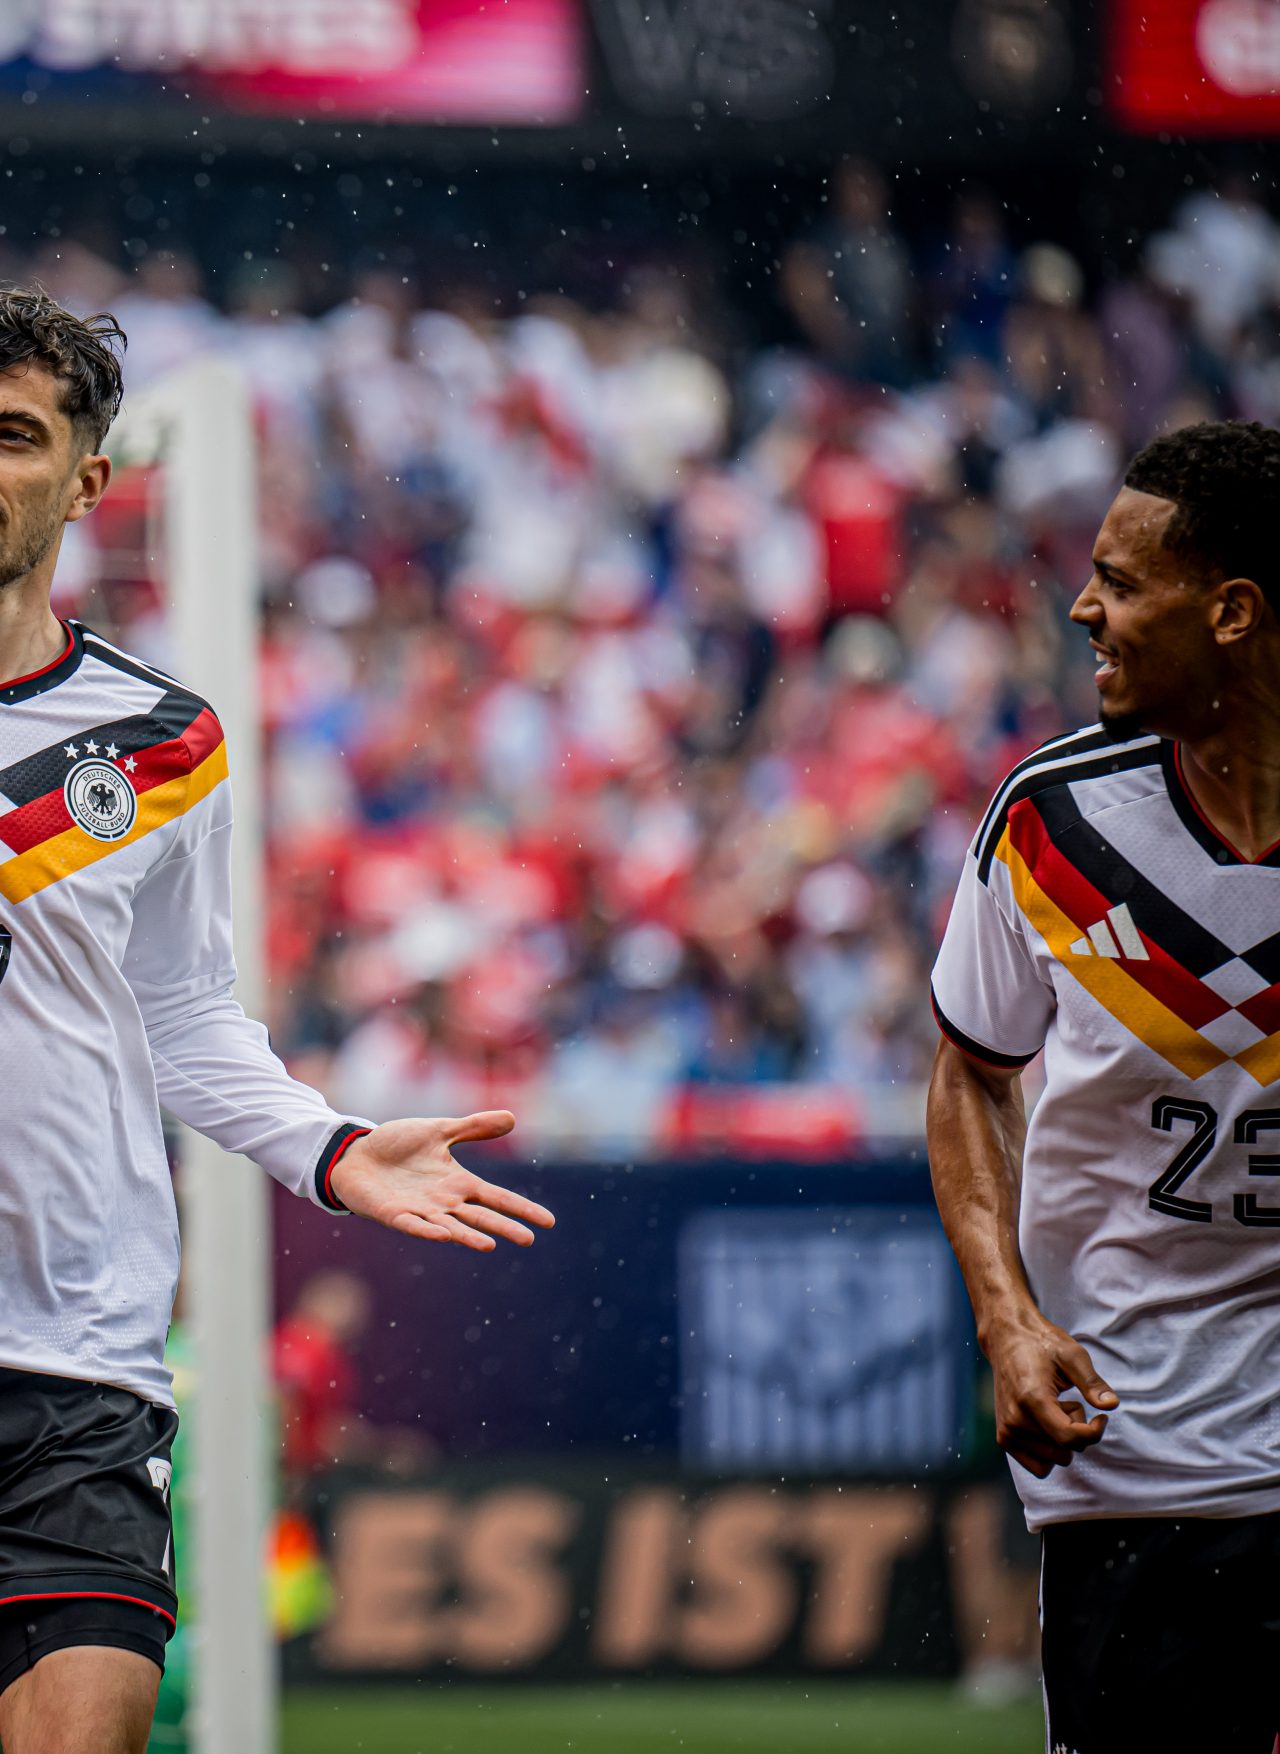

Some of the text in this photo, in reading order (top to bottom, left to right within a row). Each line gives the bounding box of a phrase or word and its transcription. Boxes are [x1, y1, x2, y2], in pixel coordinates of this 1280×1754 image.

[78, 802, 126, 829] FUSSBALL-BUND
[82, 770, 122, 789] DEUTSCHER
[1148, 1094, 1280, 1228] 23
[318, 1486, 578, 1674] ES
[592, 1486, 934, 1674] IST
